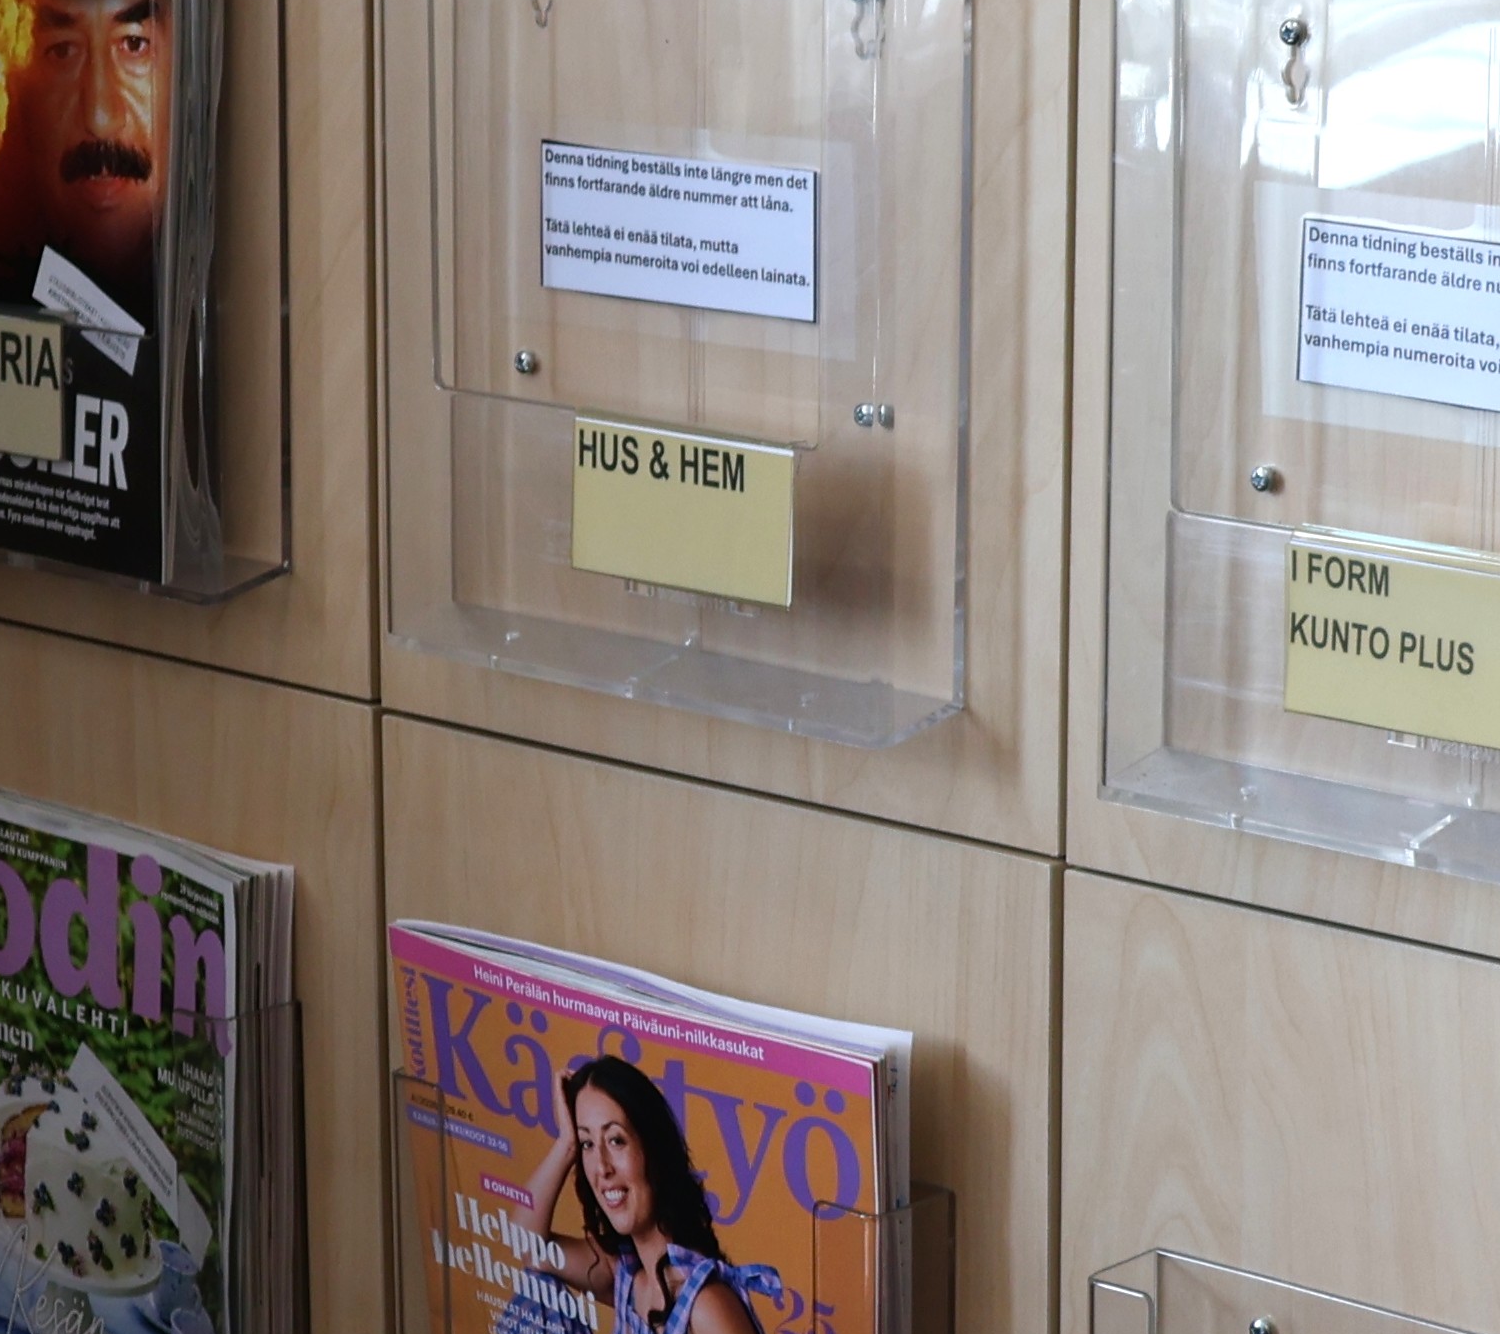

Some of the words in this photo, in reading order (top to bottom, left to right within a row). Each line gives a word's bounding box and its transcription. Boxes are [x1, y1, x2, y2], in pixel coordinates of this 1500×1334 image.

[1307, 253, 1345, 272] finns
[1349, 259, 1436, 285] fortfarande
[1441, 270, 1482, 290] äldre
[1309, 227, 1358, 248] Denna
[1362, 232, 1416, 258] tidning
[1420, 241, 1483, 266] beställs
[1304, 333, 1389, 358] vanhempia
[1393, 344, 1475, 369] numeroita
[1305, 305, 1337, 324] Tätä
[1340, 310, 1389, 332] lehteä
[1393, 318, 1407, 334] ei
[1411, 321, 1449, 340] enää
[1453, 324, 1500, 349] tilata,
[578, 430, 639, 475] HUS
[650, 441, 669, 479] &
[680, 445, 745, 493] HEM
[1292, 550, 1297, 581] I
[1307, 556, 1389, 597] FORM
[1290, 613, 1389, 659] KUNTO
[1400, 630, 1474, 675] PLUS
[1, 978, 129, 1037] KUVALEHTI
[474, 964, 504, 988] Heini
[506, 975, 550, 1005] Perälän
[553, 990, 621, 1026] hurmaavat
[623, 1010, 764, 1061] Päiväuni-nilkkasukat
[455, 1192, 566, 1271] Helppo
[430, 1228, 599, 1332] hellemuoti
